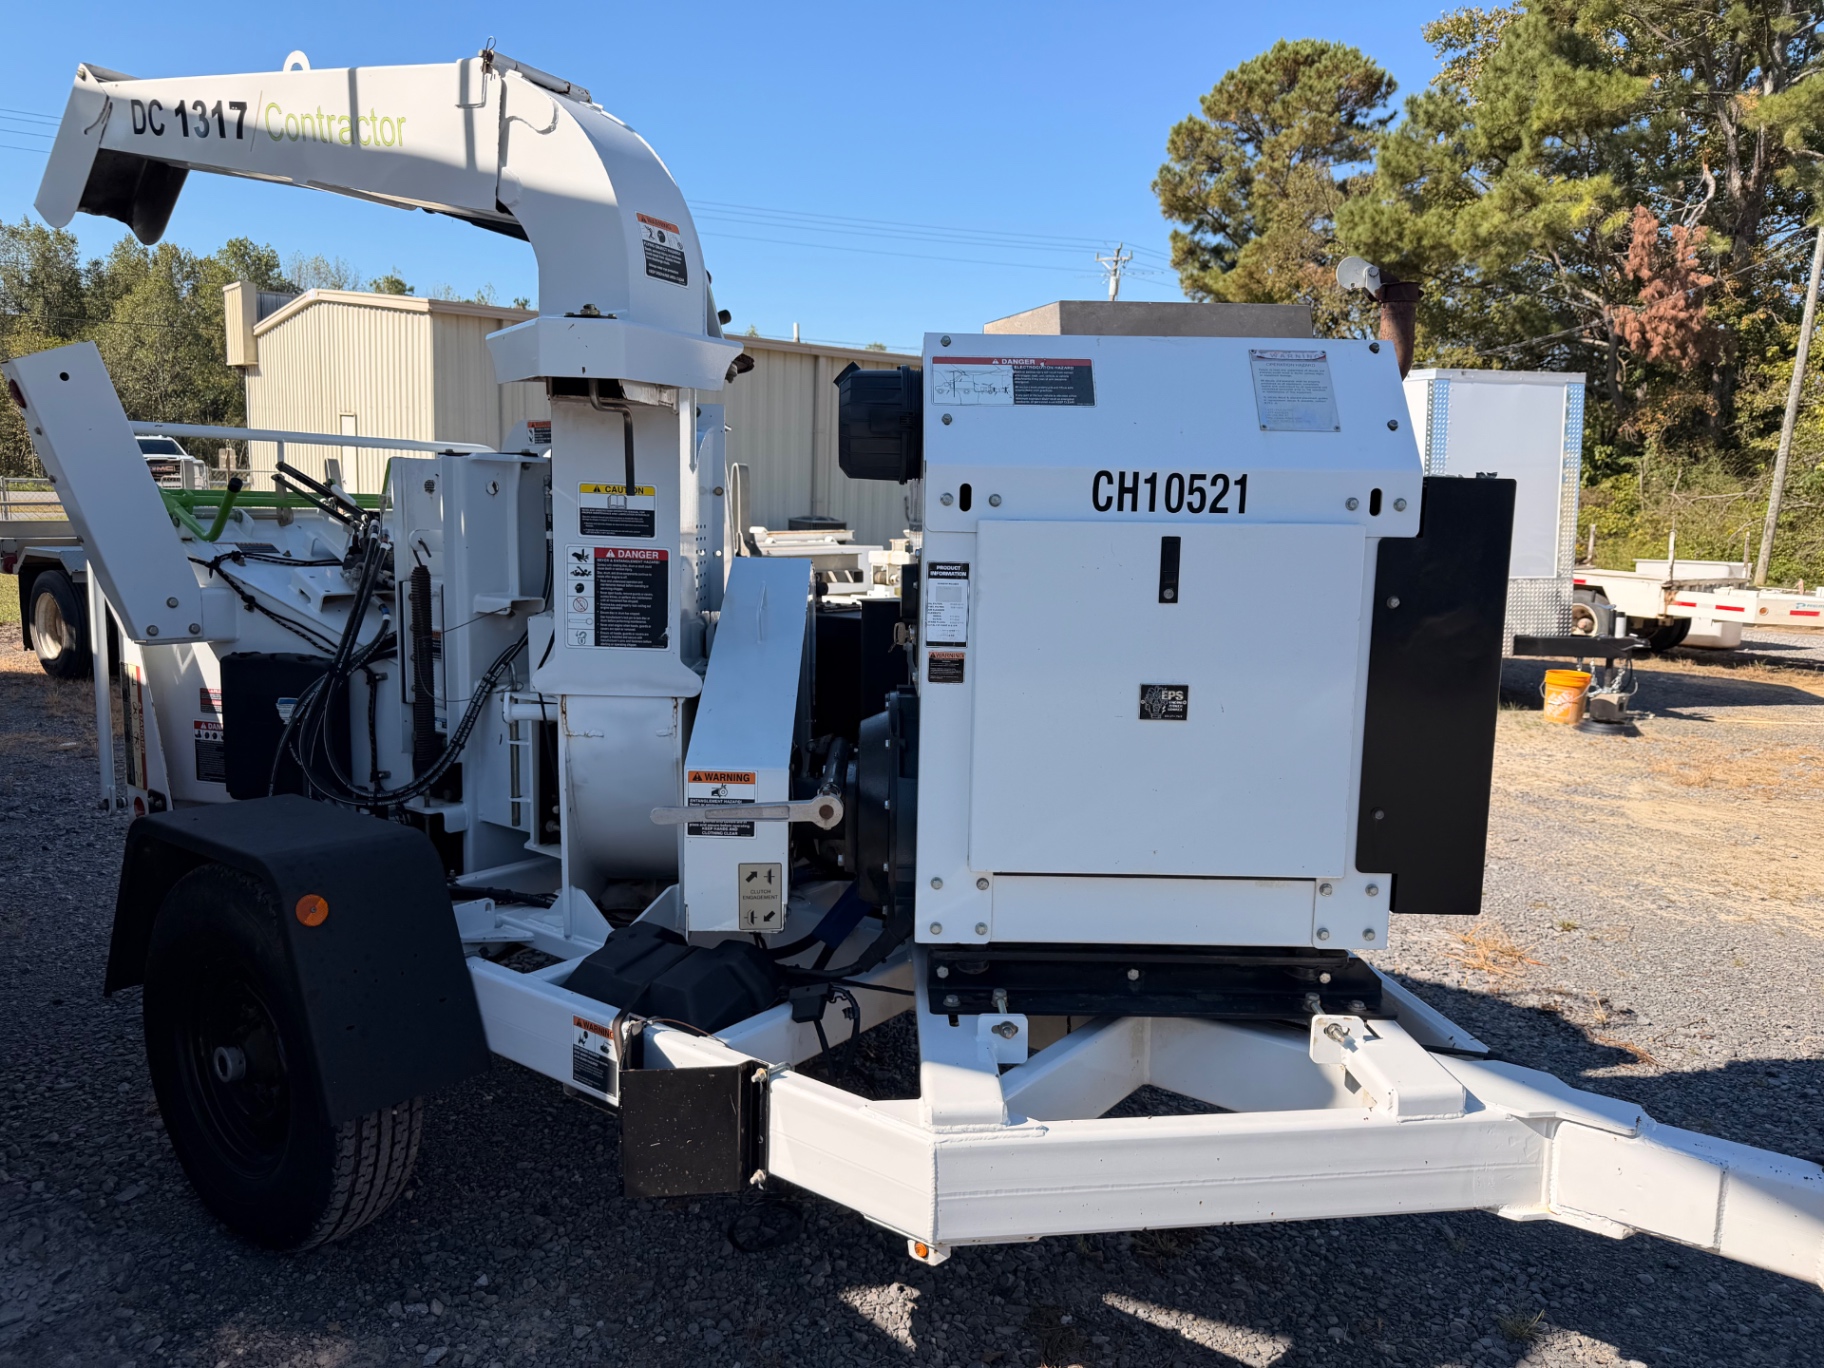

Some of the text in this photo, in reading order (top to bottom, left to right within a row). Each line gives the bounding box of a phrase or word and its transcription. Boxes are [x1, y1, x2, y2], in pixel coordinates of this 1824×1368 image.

[130, 99, 406, 147] DC 1317 Contractor
[1092, 470, 1248, 514] CH10521
[617, 549, 659, 559] DANGER
[1161, 690, 1184, 700] EPS
[704, 772, 751, 782] WARNING
[583, 1020, 614, 1040] WARNING
